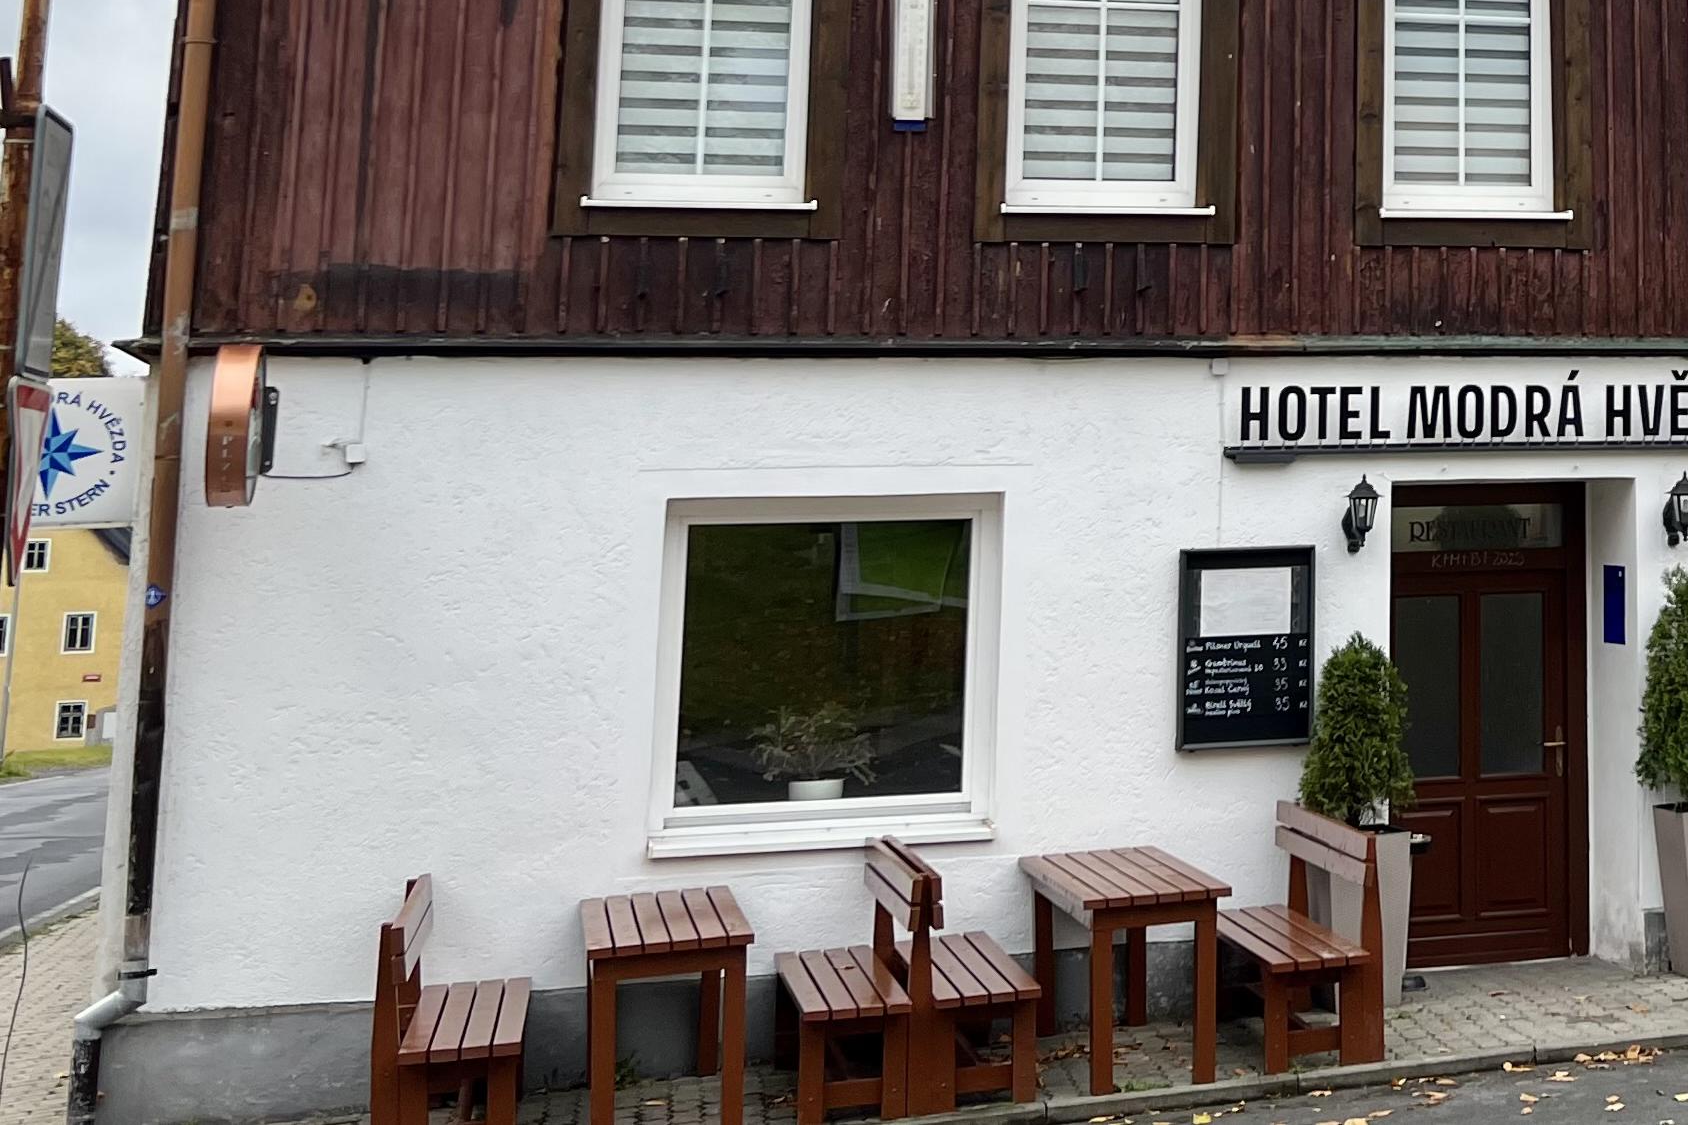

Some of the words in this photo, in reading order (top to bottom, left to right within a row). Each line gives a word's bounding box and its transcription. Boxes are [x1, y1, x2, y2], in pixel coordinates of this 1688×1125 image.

[1239, 385, 1391, 442] HOTEL
[1406, 370, 1585, 440] MODRÁ
[56, 478, 110, 515] STERN
[1205, 641, 1232, 651] Pilsner
[1272, 636, 1288, 650] 45
[1274, 677, 1288, 691] 35
[1275, 696, 1290, 711] 35
